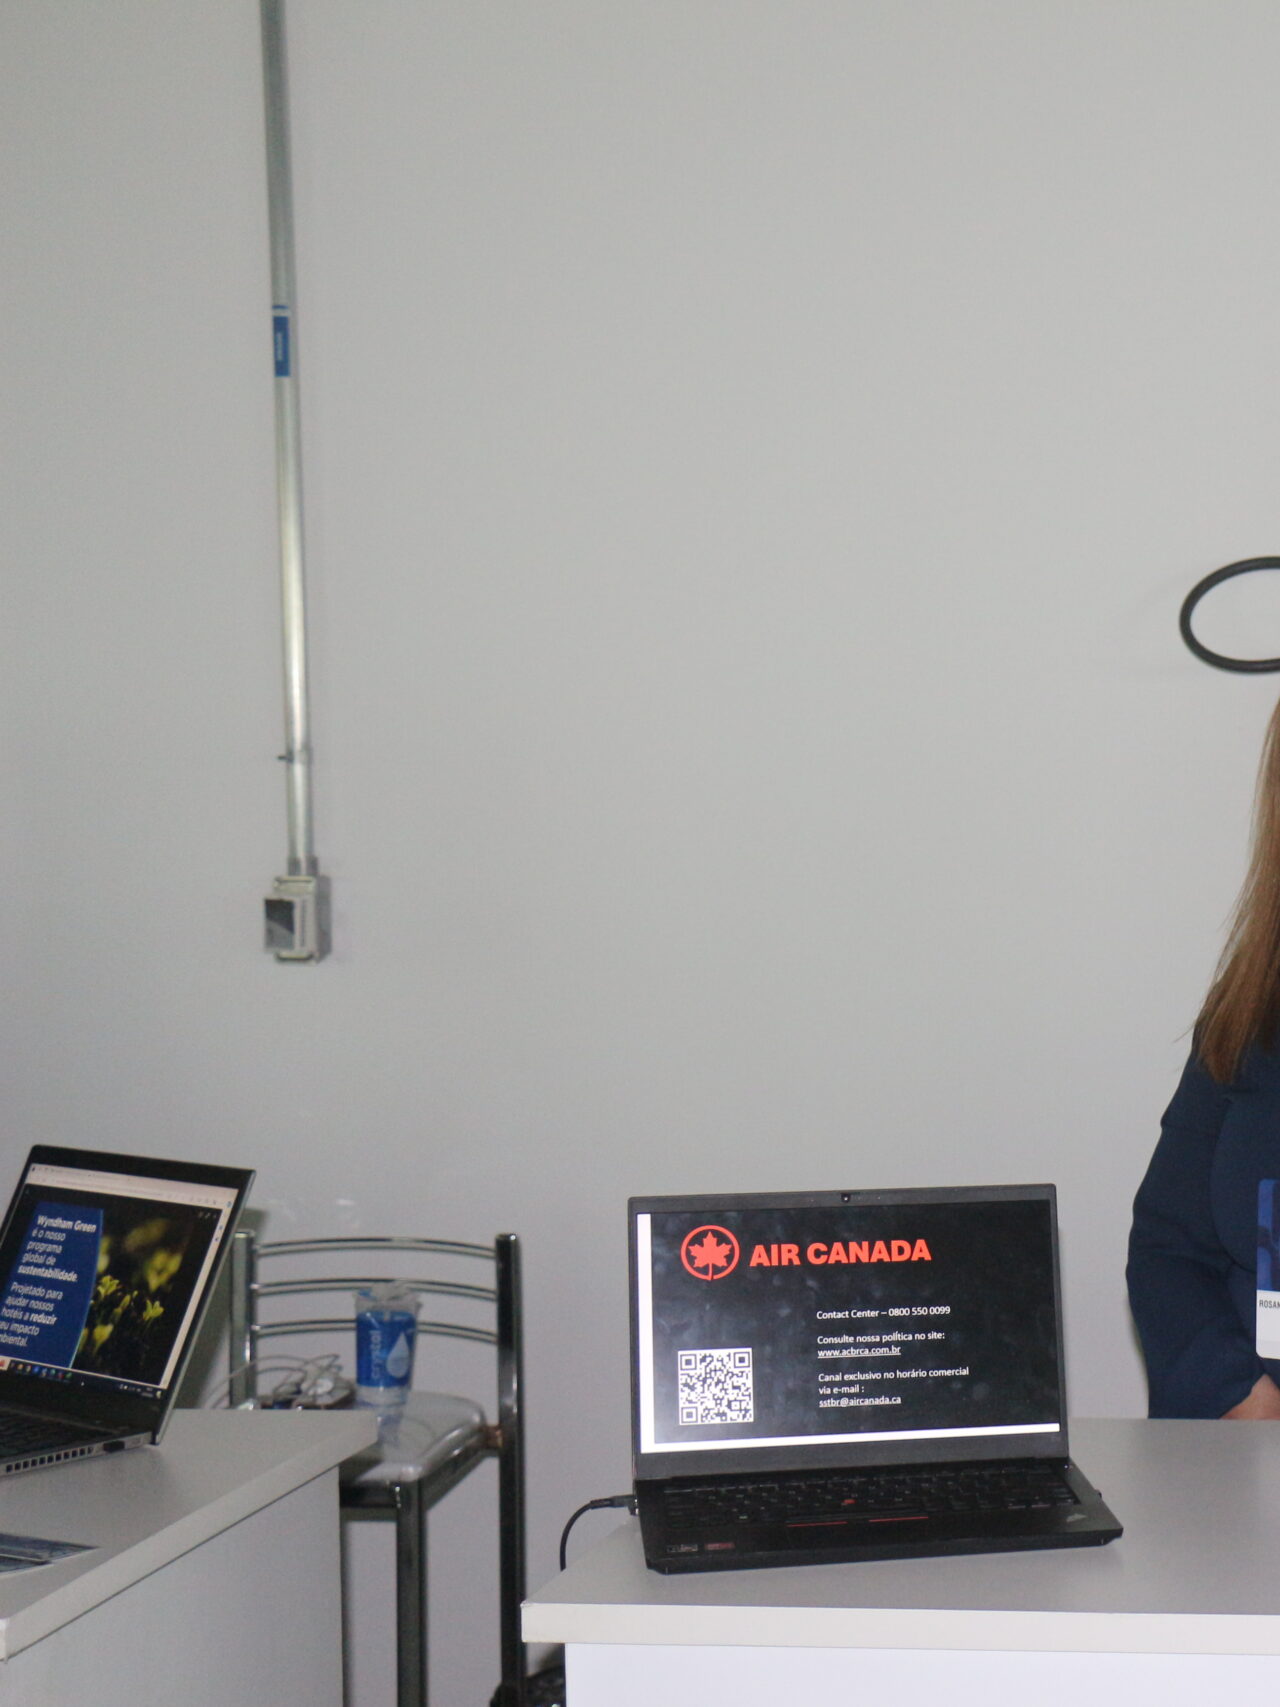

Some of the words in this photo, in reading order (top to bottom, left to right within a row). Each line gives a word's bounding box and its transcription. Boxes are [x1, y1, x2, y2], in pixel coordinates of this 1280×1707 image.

[37, 1215, 74, 1229] Wyndham
[74, 1220, 97, 1232] Green
[45, 1230, 66, 1241] nosso
[27, 1241, 62, 1253] programa
[750, 1243, 801, 1267] AIR
[807, 1239, 932, 1265] CANADA
[22, 1252, 46, 1264] global
[45, 1255, 56, 1266] de
[11, 1281, 46, 1297] Projetado
[45, 1289, 63, 1300] para
[5, 1296, 29, 1307] ajudar
[29, 1300, 55, 1311] nossos
[29, 1312, 57, 1325] reduzir
[816, 1310, 849, 1320] Contact
[851, 1308, 879, 1318] Center
[888, 1307, 910, 1316] 0800
[911, 1306, 928, 1316] 550
[929, 1306, 951, 1315] 0099
[9, 1322, 40, 1336] impacto
[817, 1334, 854, 1344] Consulte
[856, 1335, 880, 1343] nossa
[882, 1331, 913, 1343] política
[927, 1331, 945, 1339] site:
[817, 1345, 901, 1358] www.acbrca.com.br
[818, 1372, 842, 1382] Canal
[844, 1370, 881, 1381] exclusivo
[883, 1371, 895, 1379] no
[896, 1368, 927, 1379] horário
[928, 1366, 970, 1377] comercial
[818, 1385, 831, 1394] via
[833, 1384, 860, 1394] e-mail
[818, 1395, 902, 1407] sstbr@aircanada.ca
